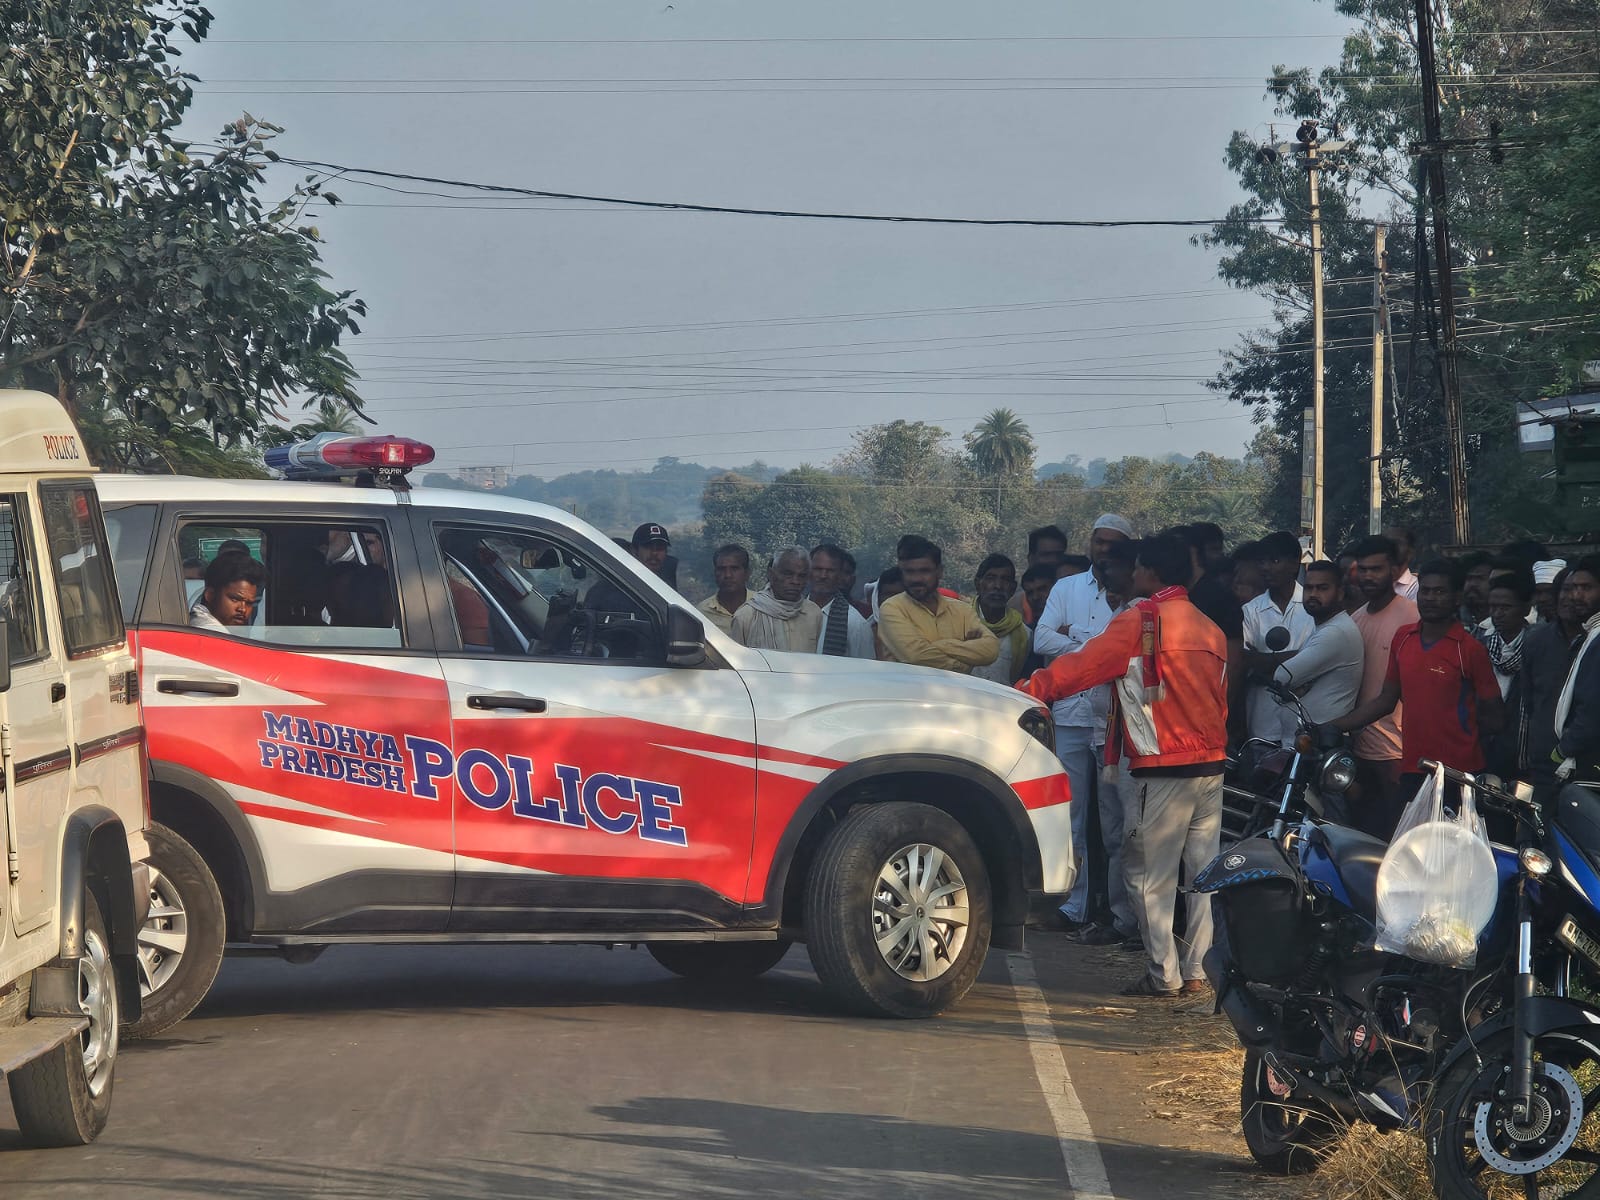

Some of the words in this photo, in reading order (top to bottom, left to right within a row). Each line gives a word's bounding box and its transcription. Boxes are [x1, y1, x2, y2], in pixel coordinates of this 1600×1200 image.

[43, 435, 79, 460] POLICE
[262, 710, 403, 763] MADHYA
[32, 760, 54, 773] पुलिस
[257, 739, 407, 794] PRADESH
[404, 734, 689, 847] POLICE
